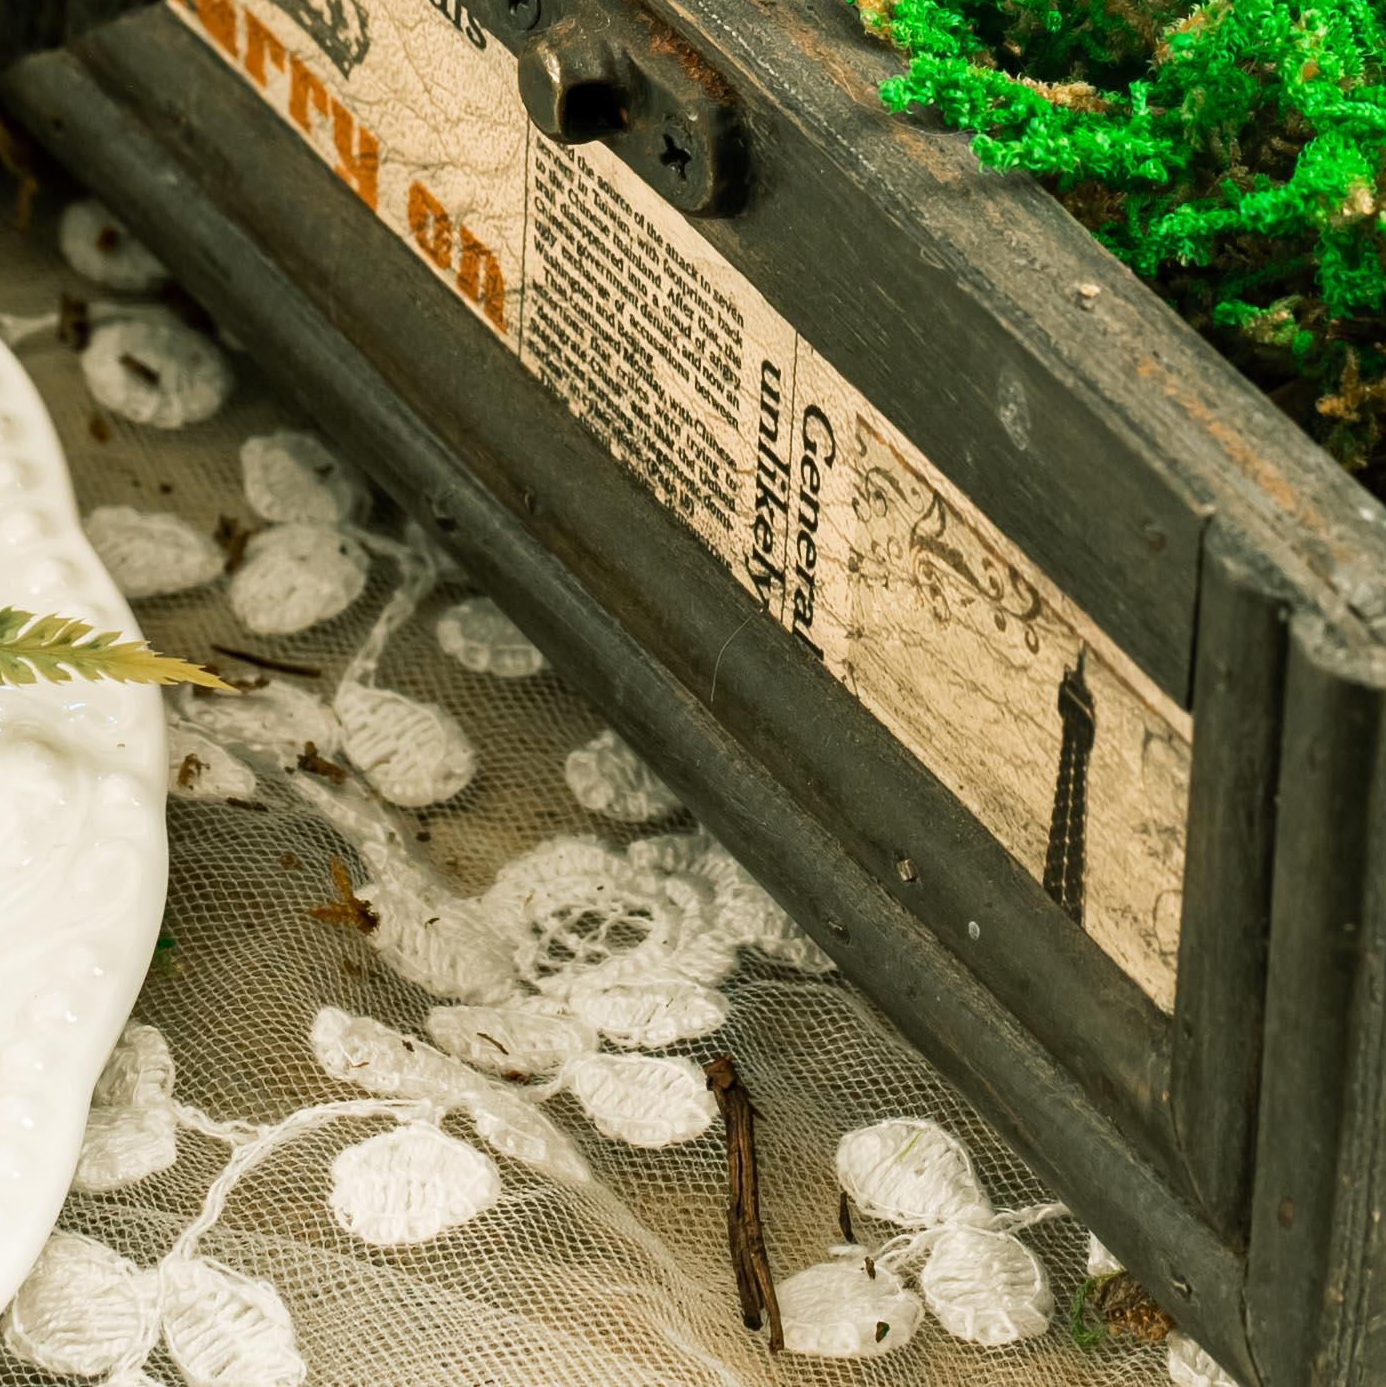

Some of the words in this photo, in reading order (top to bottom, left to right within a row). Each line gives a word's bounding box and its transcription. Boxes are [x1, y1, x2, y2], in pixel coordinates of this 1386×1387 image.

[533, 234, 593, 311] Washington
[595, 296, 614, 328] and
[534, 193, 574, 246] Chinese
[576, 237, 638, 312] government
[640, 297, 680, 355] denials,
[681, 340, 701, 373] and
[702, 362, 724, 396] now
[726, 386, 739, 411] an
[535, 155, 545, 176] to
[548, 166, 564, 194] the
[568, 185, 609, 239] Chinese
[667, 281, 694, 323] After
[724, 339, 741, 370] the
[560, 197, 623, 276] disappeared
[628, 263, 647, 298] into
[652, 292, 659, 309] a
[662, 299, 691, 341] cloud
[695, 330, 705, 355] of
[709, 347, 740, 394] angry
[561, 240, 610, 305] exchange
[614, 294, 624, 318] of
[629, 309, 689, 384] accusations
[694, 374, 738, 432] between
[577, 151, 594, 182] the
[597, 172, 632, 219] source
[634, 206, 644, 230] of
[647, 219, 663, 249] the
[665, 237, 697, 284] attack
[712, 286, 744, 330] seven
[591, 186, 633, 243] Taiwan,
[637, 231, 659, 267] with
[663, 255, 714, 324] footprints
[717, 310, 742, 349] back
[568, 291, 620, 355] continued
[669, 391, 692, 428] with
[694, 415, 737, 474] Chinese
[590, 331, 611, 368] that
[686, 430, 719, 480] trying
[725, 471, 736, 494] to
[742, 359, 791, 609] unlikely
[793, 404, 837, 663] General
